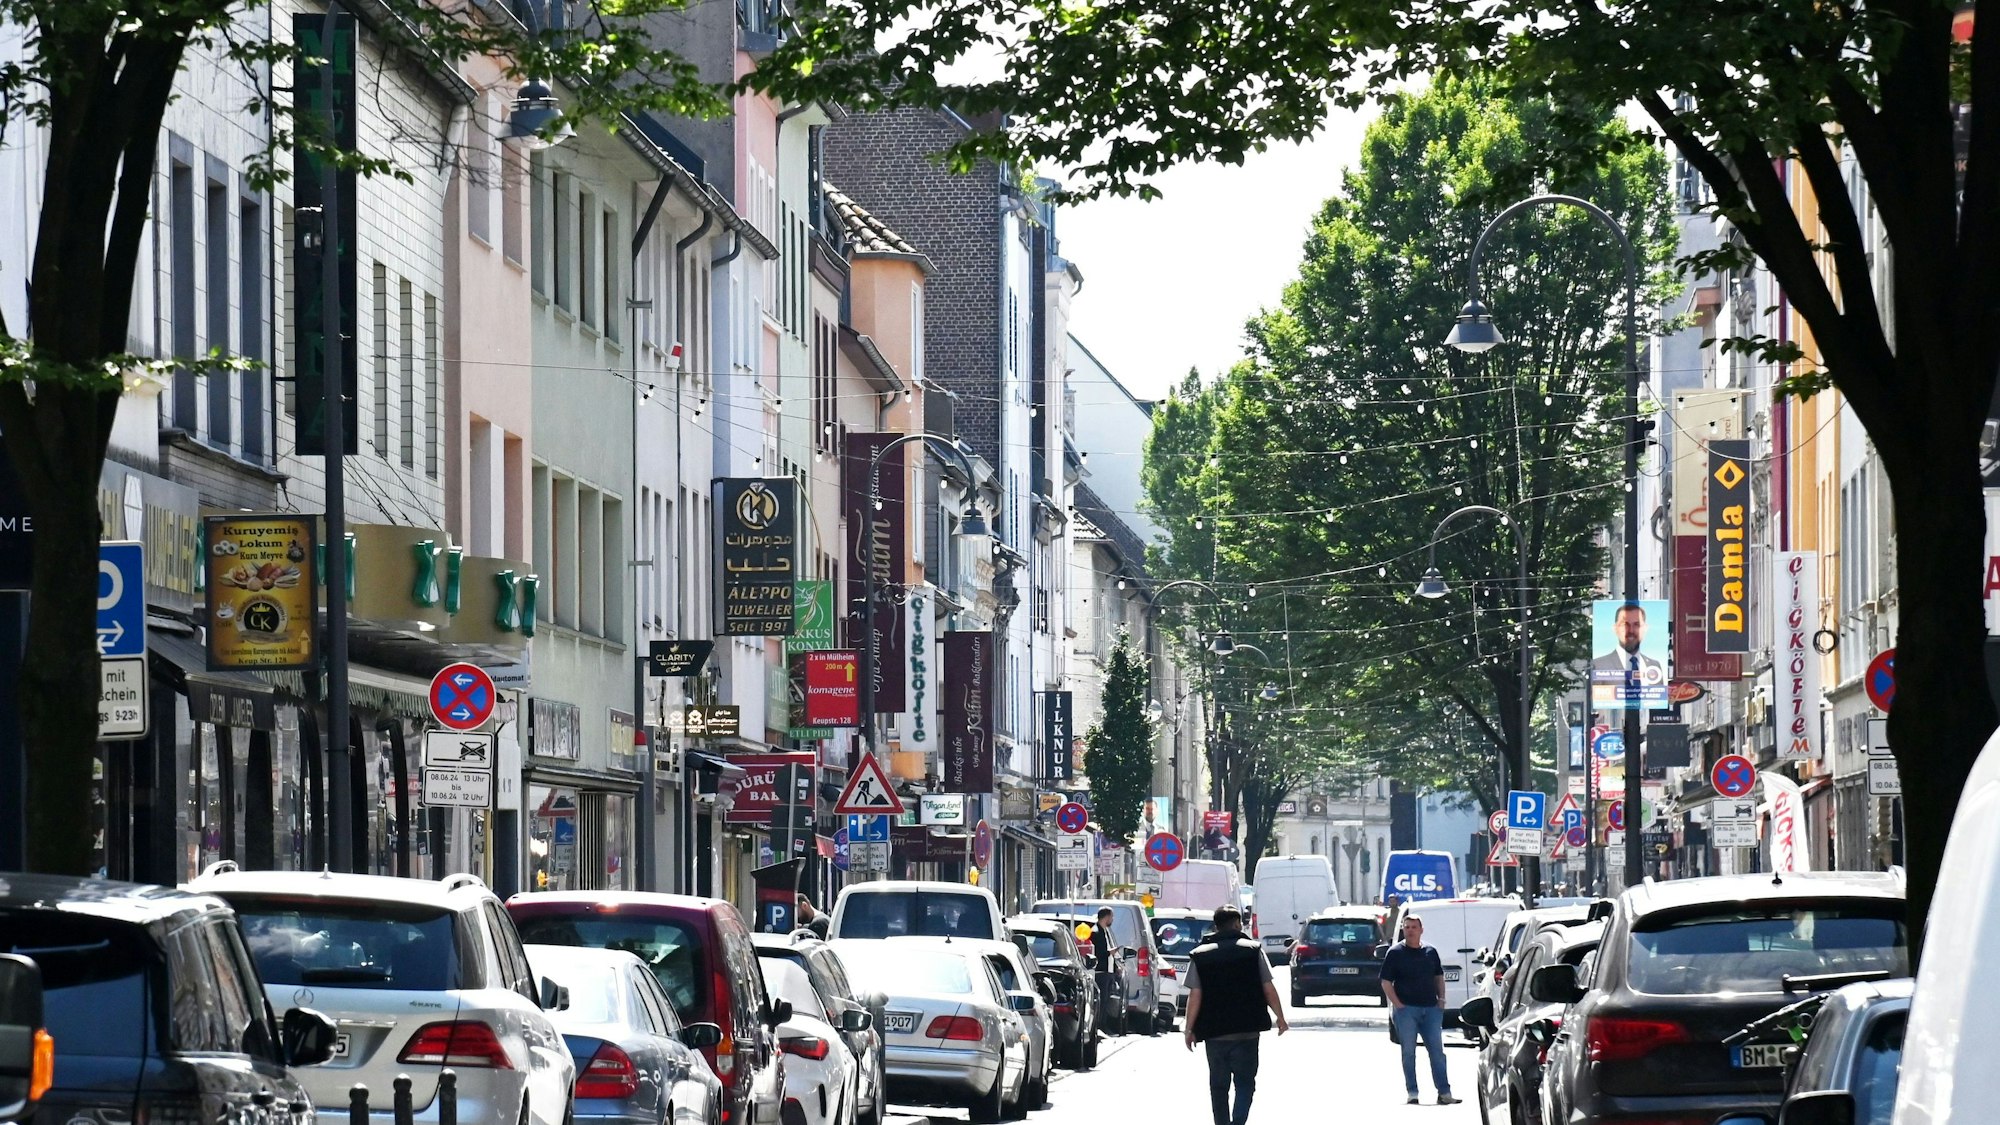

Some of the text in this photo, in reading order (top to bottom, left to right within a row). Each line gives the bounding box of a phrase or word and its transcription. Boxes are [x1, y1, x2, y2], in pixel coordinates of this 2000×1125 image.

[223, 526, 298, 536] Kuruyemiş
[239, 540, 283, 548] Lokum
[726, 533, 792, 549] مجوهرات
[240, 551, 284, 560] Kuru Meyve
[727, 552, 792, 577] حلب
[1714, 504, 1743, 633] Damla
[728, 586, 792, 600] ALEPPO
[250, 613, 272, 631] CK
[729, 622, 787, 633] Seit 1991
[787, 640, 831, 651] KONYA
[656, 654, 695, 662] CLARITY
[1683, 659, 1731, 672] seit 1970
[106, 670, 126, 683] mit
[100, 688, 137, 701] schein
[807, 685, 855, 696] komagene
[115, 709, 139, 722] 9-23h
[812, 717, 839, 726] Keupstr.
[814, 729, 833, 738] PIDE
[1053, 694, 1064, 778] İLKNUR
[1600, 742, 1625, 751] EFES
[953, 736, 963, 785] Backsube
[430, 773, 458, 781] 08.06.24
[431, 792, 457, 800] 10.06.24
[923, 800, 946, 810] Vegan
[1516, 796, 1536, 824] P
[1568, 812, 1577, 828] P
[772, 905, 785, 925] P
[884, 1016, 911, 1027] 1907
[1742, 1047, 1765, 1065] BM
